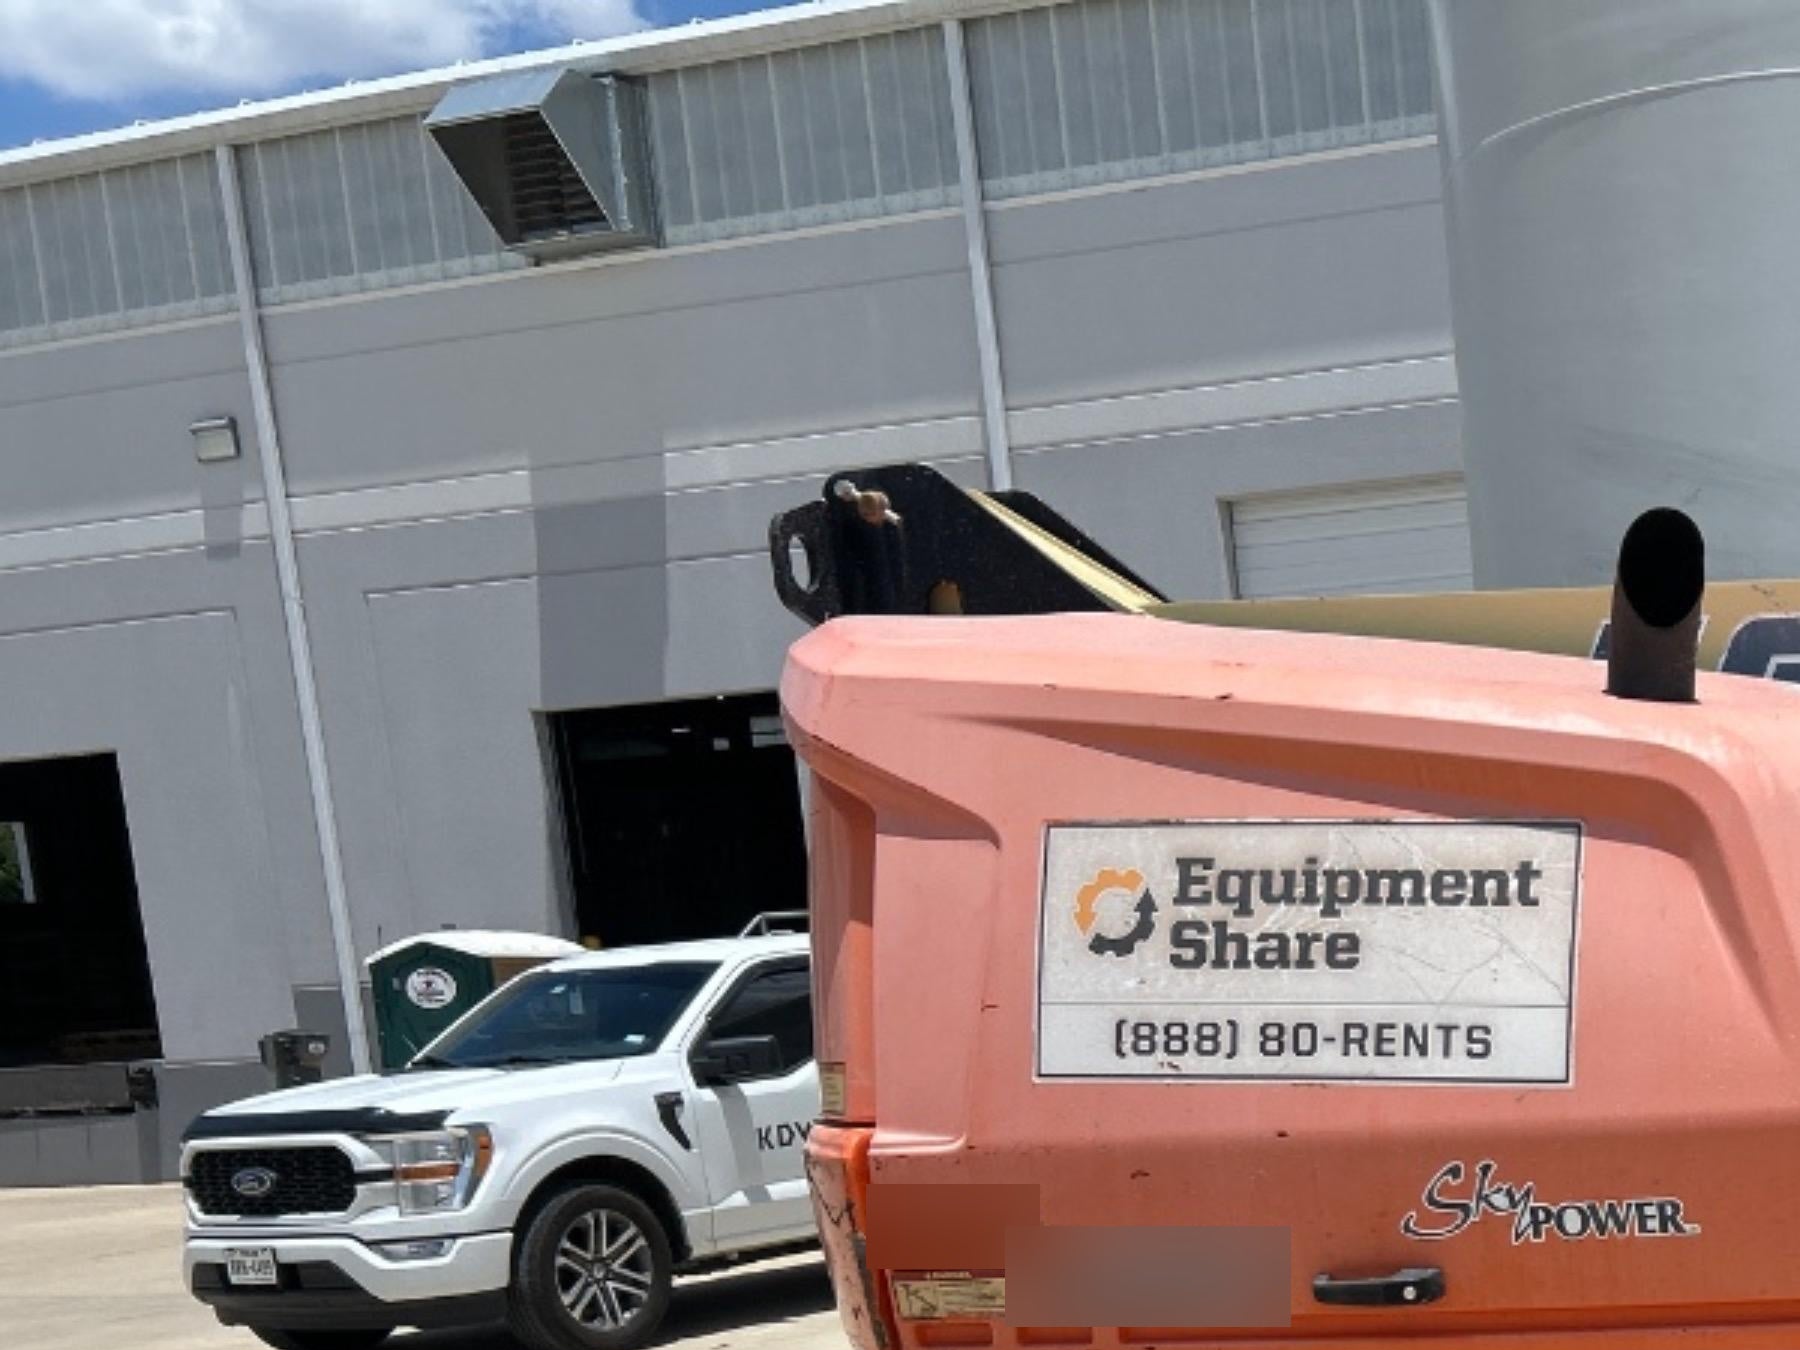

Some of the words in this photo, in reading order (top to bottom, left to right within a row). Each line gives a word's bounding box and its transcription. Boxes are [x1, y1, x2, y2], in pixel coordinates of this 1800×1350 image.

[1172, 856, 1541, 918] Equipment
[1169, 919, 1361, 970] Share
[1115, 1018, 1238, 1060] (888)
[1259, 1022, 1492, 1059] 80-RENTS
